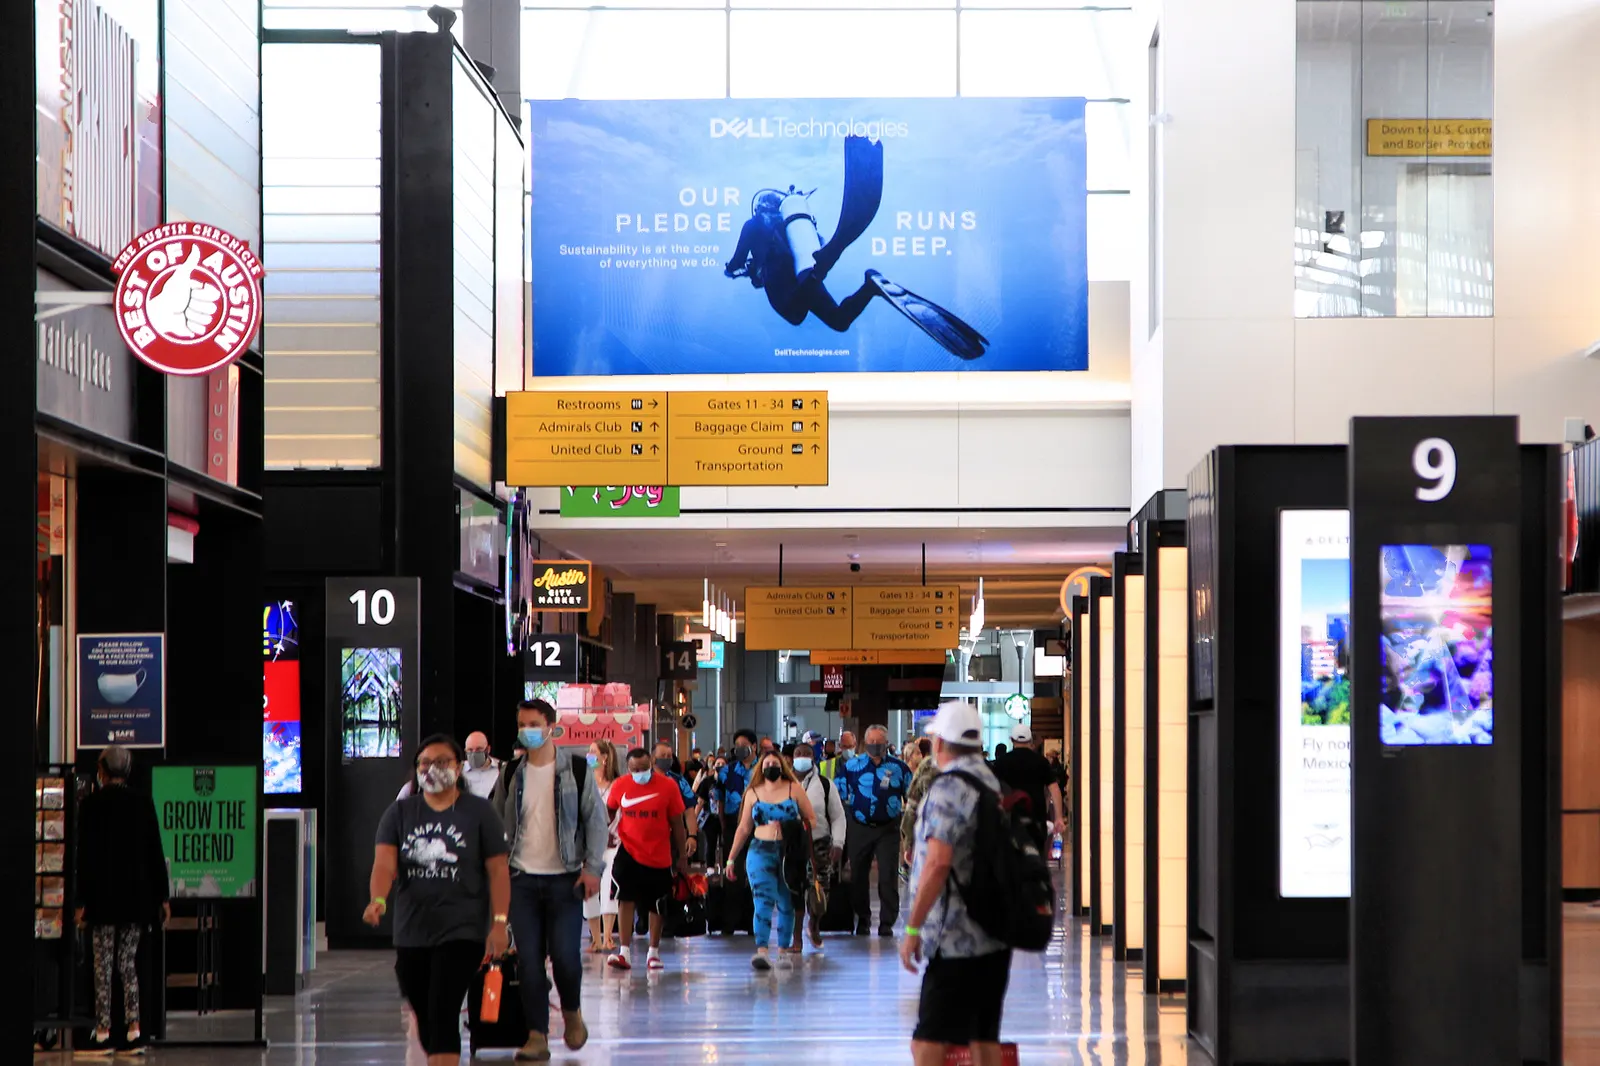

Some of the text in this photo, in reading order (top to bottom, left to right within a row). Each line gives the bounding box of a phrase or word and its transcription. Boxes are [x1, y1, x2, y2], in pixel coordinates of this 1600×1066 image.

[709, 117, 909, 146] DELL Technologies
[1382, 125, 1414, 134] Down
[1418, 126, 1429, 134] to
[1433, 125, 1454, 134] U.S.
[1383, 139, 1492, 149] and Border Protecti
[679, 186, 741, 207] OUR
[615, 212, 732, 234] PLEDGE
[896, 211, 977, 230] RUNS
[113, 223, 261, 275] THE AUSTIN CHRONICLE
[559, 244, 720, 257] Sustainability is at the core
[871, 237, 952, 255] DEEP.
[599, 257, 720, 270] of everything we do.
[123, 242, 250, 353] BEST OF AUSTIN
[774, 348, 850, 357] DellTechnologies.com
[557, 399, 621, 410] Restrooms
[708, 399, 741, 410] Gates
[746, 399, 758, 409] 11
[770, 398, 784, 410] 34
[213, 379, 223, 467] JUGO
[539, 421, 622, 433] Admirals Club
[695, 421, 784, 435] Baggage Claim
[551, 444, 622, 455] United Club
[738, 444, 784, 455] Ground
[695, 460, 783, 474] Transportation
[1412, 437, 1457, 502] 9
[533, 567, 587, 590] Austin
[548, 589, 571, 597] CITY
[766, 591, 824, 600] Admirals Club
[880, 591, 901, 599] Gates
[538, 596, 581, 604] MARKET
[349, 589, 395, 625] 10
[774, 607, 824, 615] United Club
[870, 606, 930, 615] Baggage Claim
[899, 621, 930, 629] Ground
[870, 633, 930, 641] Transportation
[530, 641, 561, 667] 12
[666, 651, 691, 671] 14
[115, 729, 135, 737] SAFE
[568, 725, 615, 739] benefit
[1303, 757, 1350, 769] Mexic
[163, 800, 246, 830] GROW THE
[401, 822, 443, 851] TAMPA
[174, 833, 234, 863] LEGEND
[407, 867, 458, 881] HOCKEY
